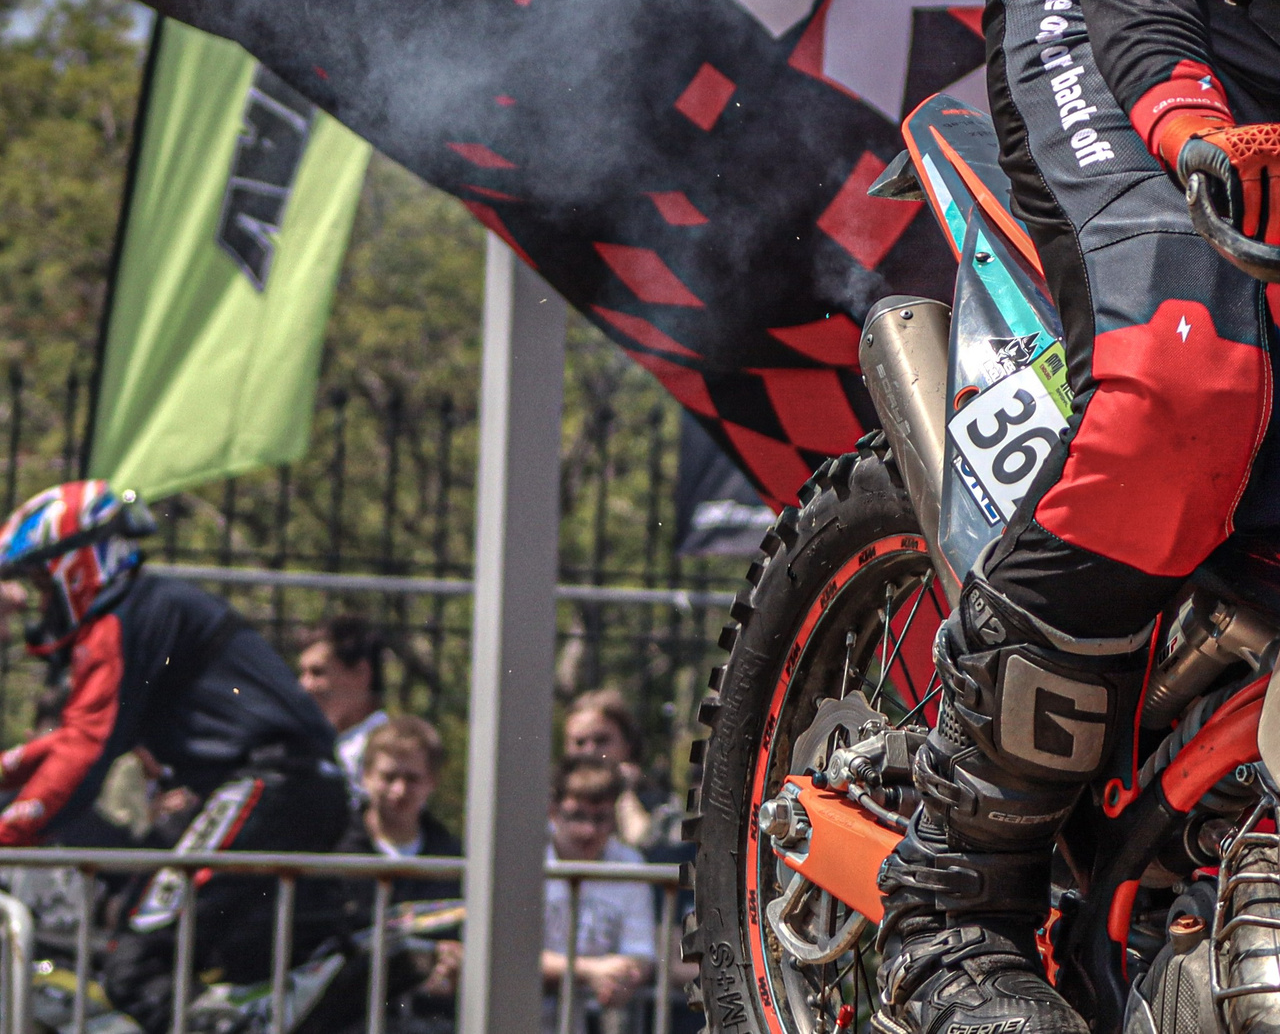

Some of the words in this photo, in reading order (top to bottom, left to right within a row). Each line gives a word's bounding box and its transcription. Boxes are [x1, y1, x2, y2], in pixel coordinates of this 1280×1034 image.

[1050, 65, 1098, 132] back
[1070, 127, 1116, 168] off
[966, 387, 1060, 510] 36
